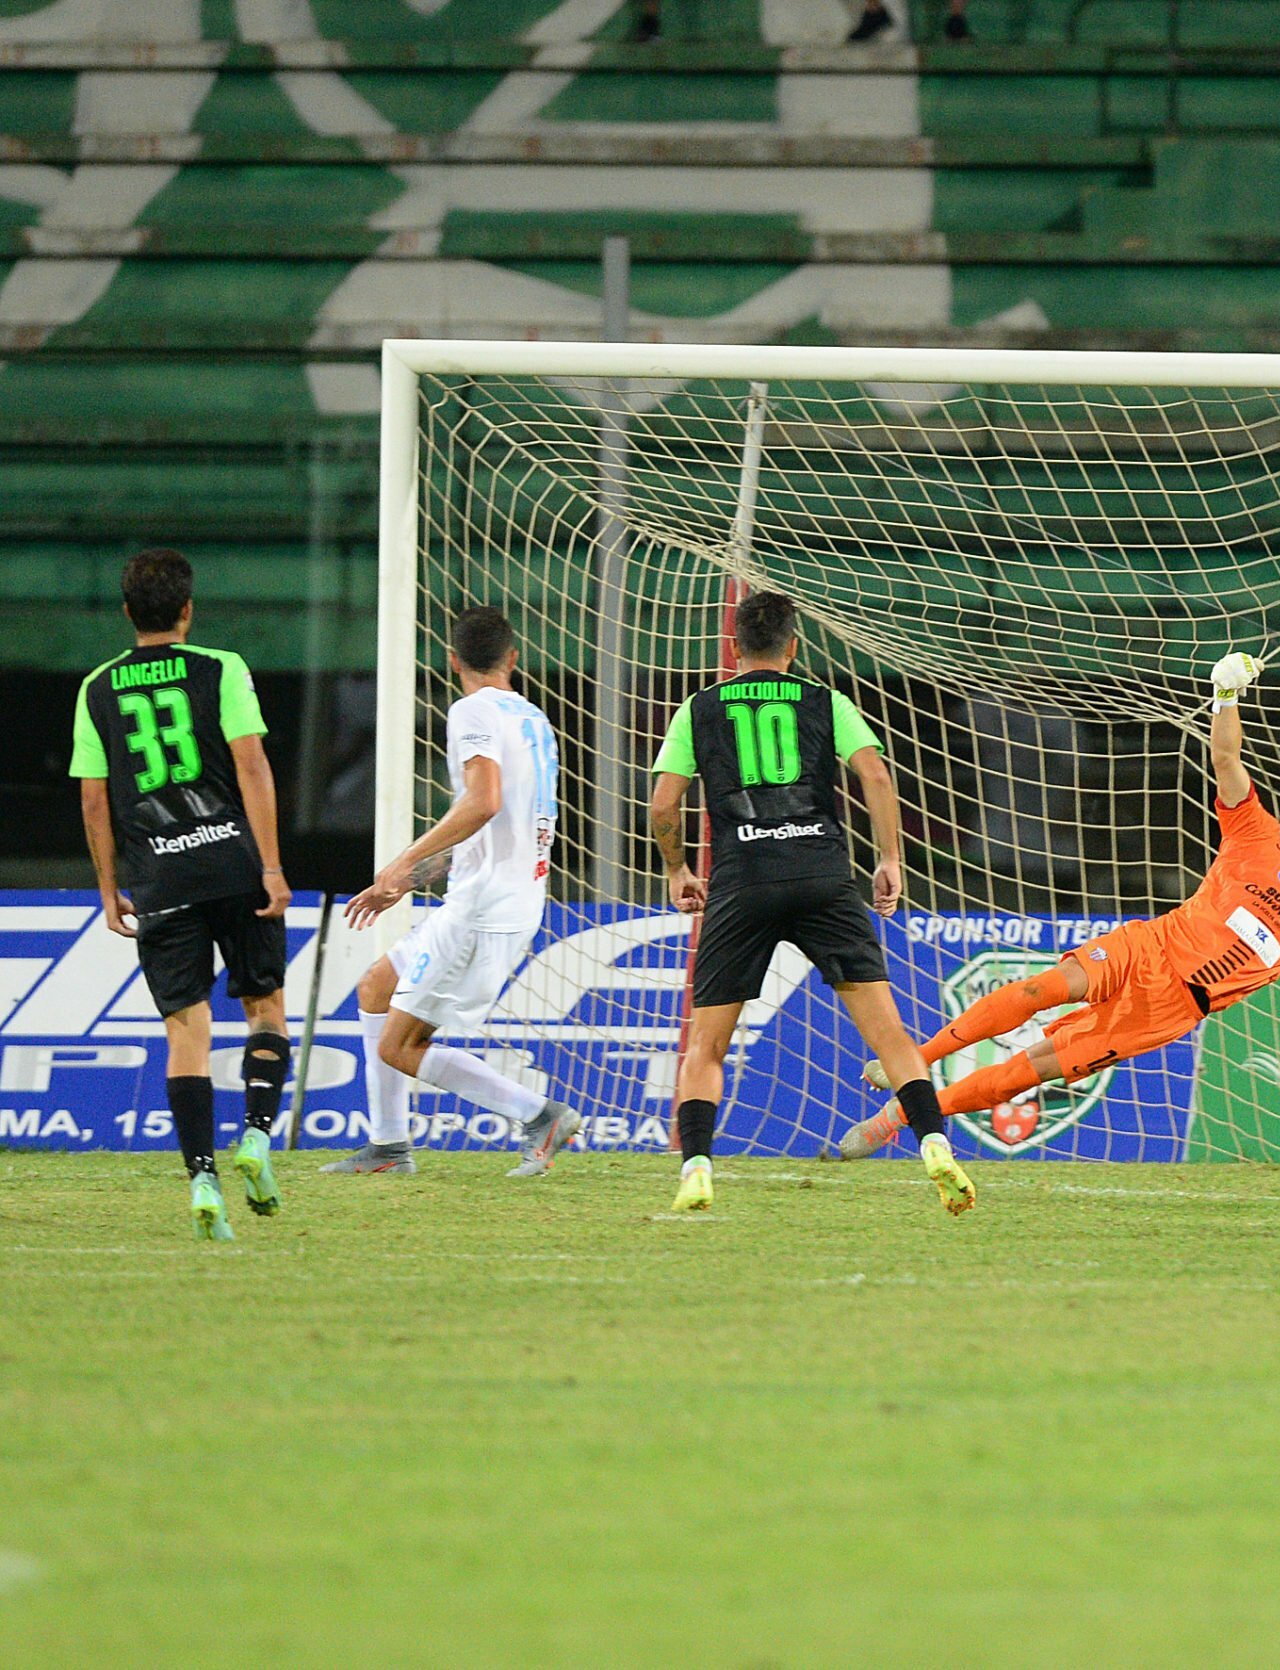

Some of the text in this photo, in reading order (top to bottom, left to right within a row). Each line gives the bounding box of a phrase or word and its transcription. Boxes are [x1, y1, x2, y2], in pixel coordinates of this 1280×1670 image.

[111, 656, 188, 691] LANGELLA
[720, 682, 802, 702] NOCCIOLINI
[117, 687, 203, 794] 33
[725, 701, 802, 788] 10
[907, 917, 1128, 945] SPONSOR TEC
